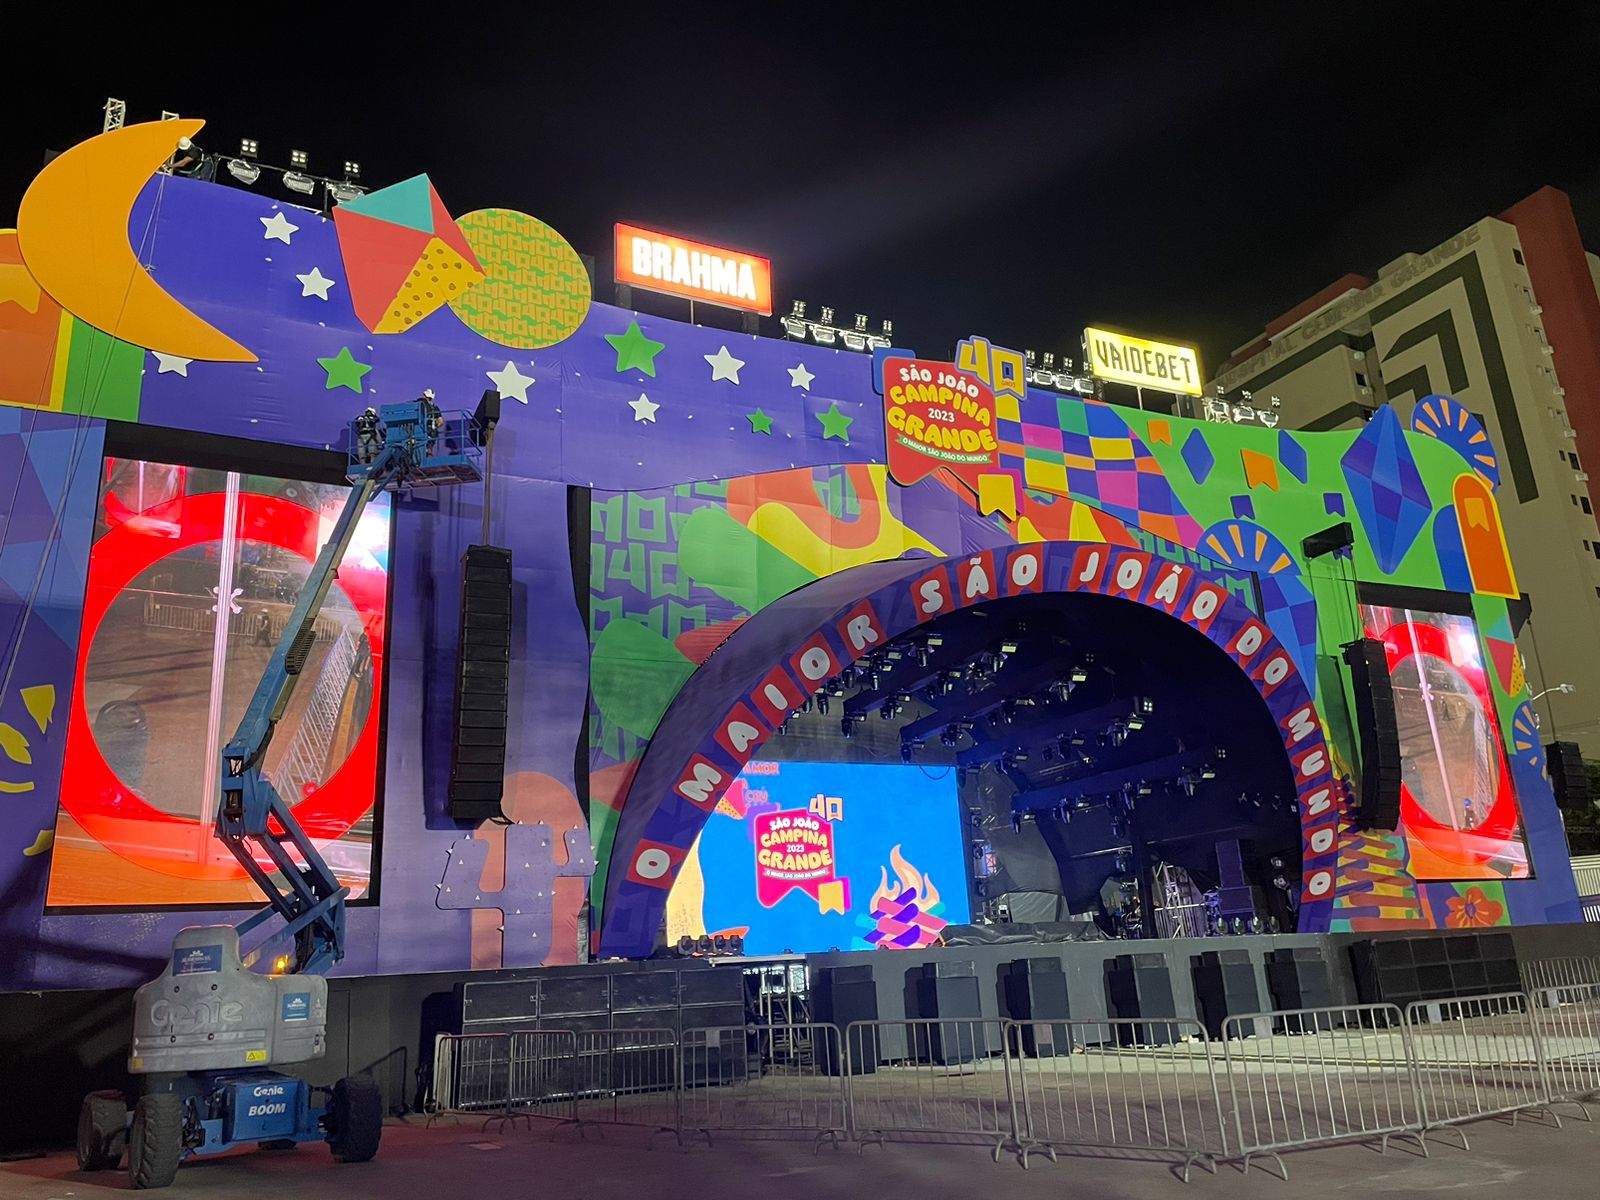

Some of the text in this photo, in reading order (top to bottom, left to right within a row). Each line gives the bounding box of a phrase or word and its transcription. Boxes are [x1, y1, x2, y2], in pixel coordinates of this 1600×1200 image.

[631, 237, 756, 301] BRAHMA
[957, 338, 1025, 398] 40
[1095, 339, 1191, 384] VAIDEBET
[899, 364, 933, 383] SÃO
[937, 371, 980, 399] JOÃO
[889, 384, 992, 428] CAMPINA
[927, 407, 956, 423] 2023
[887, 406, 998, 453] GRANDE
[928, 446, 940, 457] SÃO
[941, 451, 956, 461] JOÃO
[956, 454, 967, 462] DO
[635, 551, 1334, 897] O MAIOR SÃO JOÃO DO MUNDO
[809, 793, 843, 822] 40
[769, 816, 820, 831] SÃO JOÃO
[760, 829, 828, 848] CAMPINA
[786, 844, 805, 853] 2023
[758, 849, 833, 871] GRANDE
[151, 996, 244, 1027] Genie
[253, 1085, 285, 1097] Genie
[248, 1103, 286, 1117] BOOM
